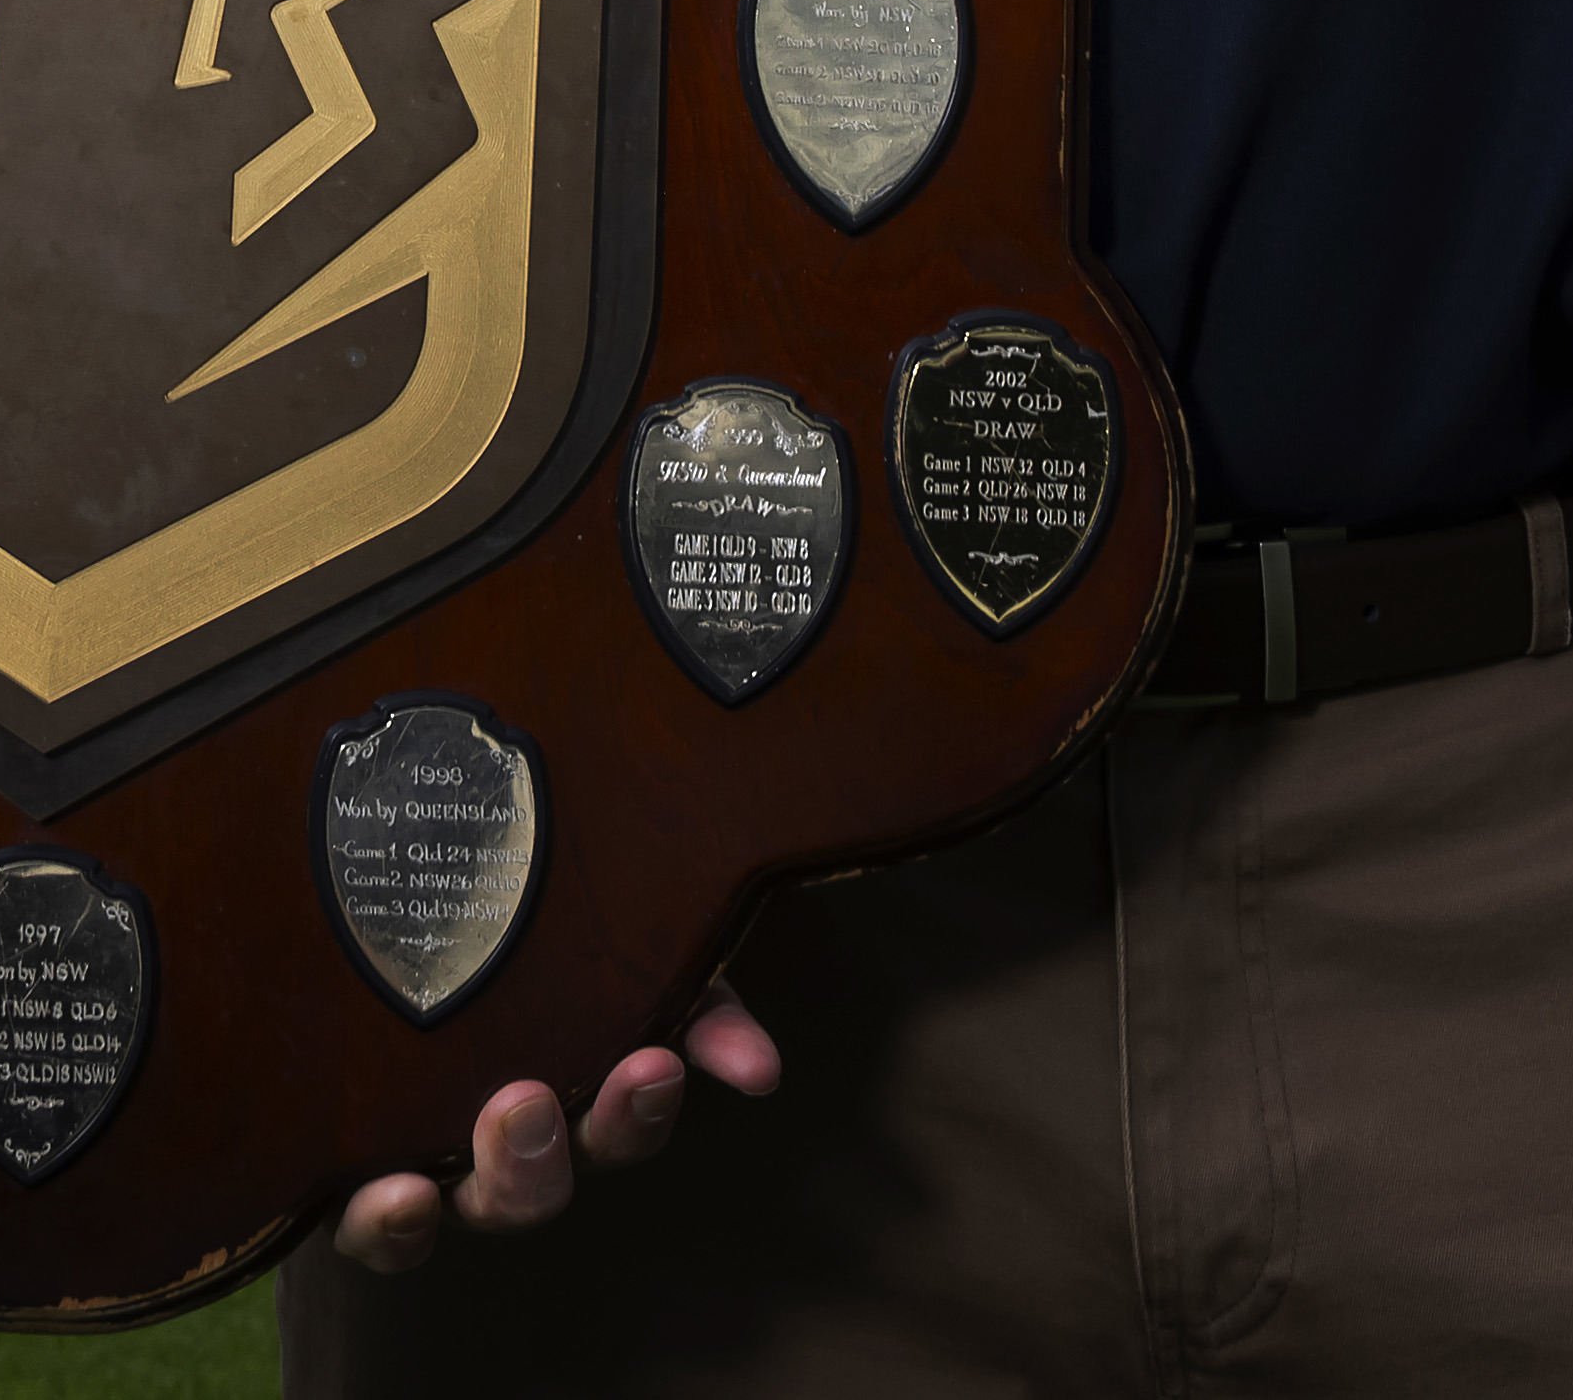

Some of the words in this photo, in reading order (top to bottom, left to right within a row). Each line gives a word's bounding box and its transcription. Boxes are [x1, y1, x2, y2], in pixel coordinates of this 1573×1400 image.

[985, 371, 1028, 388] 2002
[949, 389, 996, 409] NSW
[1002, 396, 1011, 409] v
[1018, 393, 1062, 416] QLD
[974, 419, 1036, 439] DRAW
[715, 465, 728, 484] &
[738, 464, 827, 488] Queensland
[923, 453, 961, 472] Game
[966, 455, 971, 473] 1
[981, 456, 1015, 474] NSW
[1018, 459, 1033, 476] 32
[1042, 459, 1073, 480] QLD
[1078, 461, 1085, 478] 4
[923, 477, 959, 495] Game
[963, 480, 970, 495] 2
[978, 480, 1008, 502] QLD
[1013, 482, 1028, 499] 26
[1036, 483, 1068, 500] NSW
[1073, 485, 1086, 501] 18
[710, 494, 774, 517] DRAW
[923, 502, 959, 521] Game
[963, 505, 969, 521] 3
[978, 505, 1011, 523] NSW
[1015, 508, 1028, 524] 18
[1036, 508, 1067, 530] QLD
[1073, 510, 1085, 527] 18
[674, 533, 710, 556] GAME
[713, 535, 717, 557] 1
[720, 535, 745, 557] QLD
[747, 536, 756, 557] 9
[771, 537, 797, 560] NSW
[800, 538, 808, 560] 8
[672, 561, 706, 584] GAME
[708, 562, 717, 584] 2
[720, 562, 746, 584] NSW
[750, 563, 762, 585] 12
[776, 565, 801, 587] QLD
[803, 565, 812, 587] 8
[668, 587, 702, 610] GAME
[704, 589, 712, 611] 3
[716, 589, 742, 613] NSW
[744, 590, 758, 613] 10
[772, 592, 796, 614] QLD
[798, 593, 812, 615] 10
[411, 764, 464, 785] 1998
[335, 796, 373, 818] Won
[377, 798, 397, 827] by
[406, 800, 528, 823] QUEENSLAND
[343, 840, 386, 859] Game
[389, 843, 397, 860] 1
[408, 843, 444, 864] Qld
[447, 846, 470, 863] 24
[344, 867, 389, 888] Game
[390, 870, 403, 888] 2
[409, 873, 450, 890] NSW
[346, 895, 389, 915] Game
[408, 899, 441, 922] Qld
[19, 924, 62, 945] 1997
[18, 958, 37, 986] by
[41, 962, 89, 981] NSW
[13, 999, 49, 1018] NSW
[71, 1001, 103, 1022] QLD
[14, 1032, 48, 1050] NSW
[72, 1033, 105, 1052] QLD
[16, 1063, 53, 1083] QLD
[56, 1064, 70, 1083] 18
[73, 1064, 104, 1084] NSW
